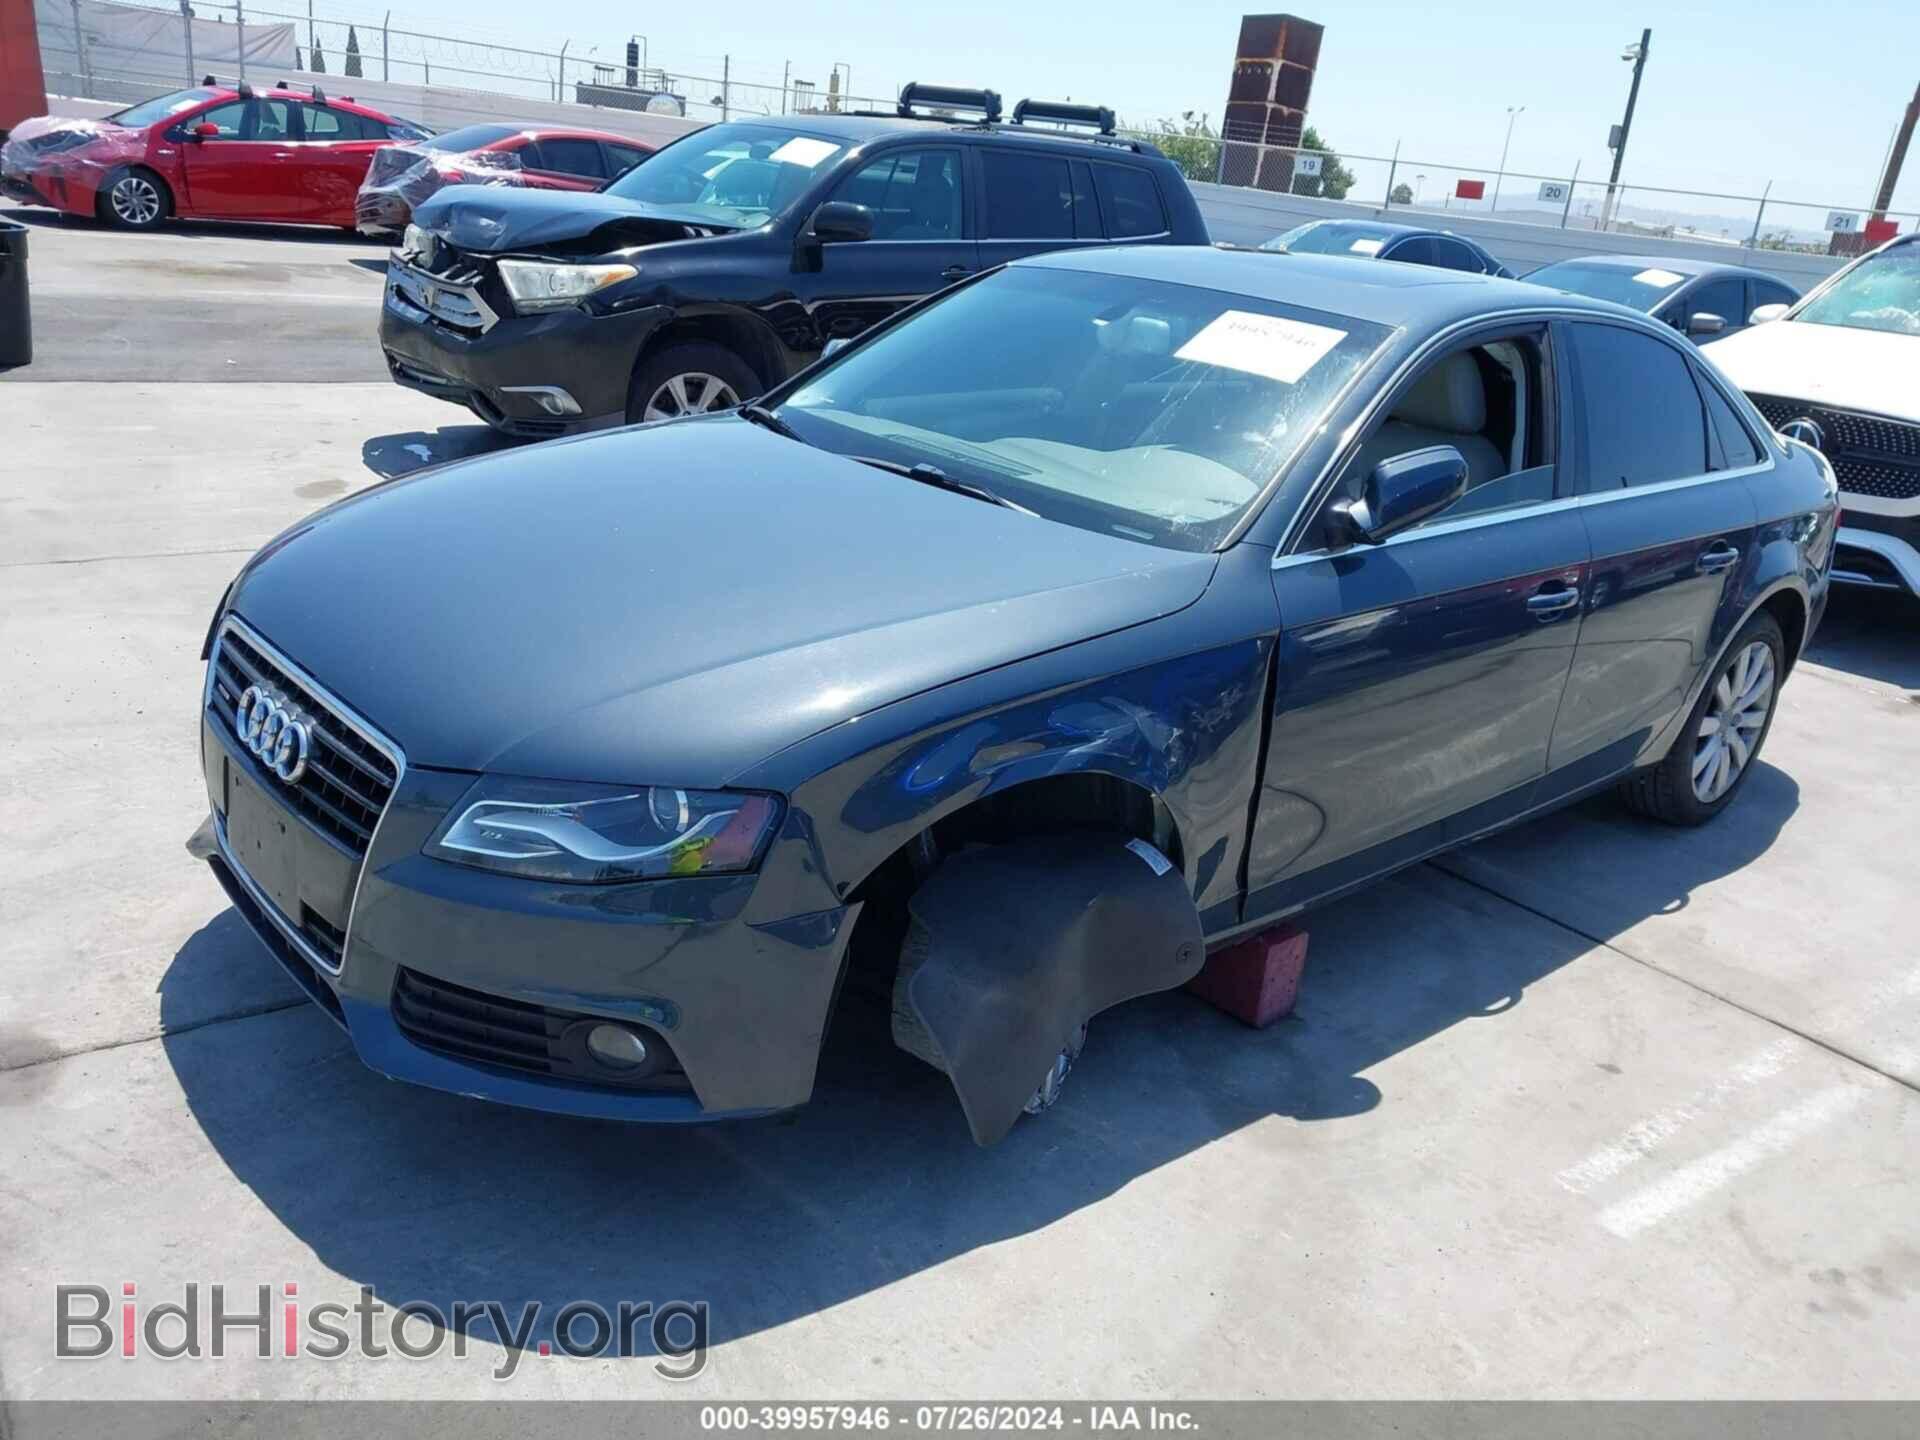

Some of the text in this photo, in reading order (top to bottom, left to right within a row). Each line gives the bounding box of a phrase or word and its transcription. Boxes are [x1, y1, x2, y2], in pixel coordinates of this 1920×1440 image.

[1303, 160, 1315, 170] 19
[1545, 186, 1561, 198] 20
[1833, 216, 1849, 228] 21
